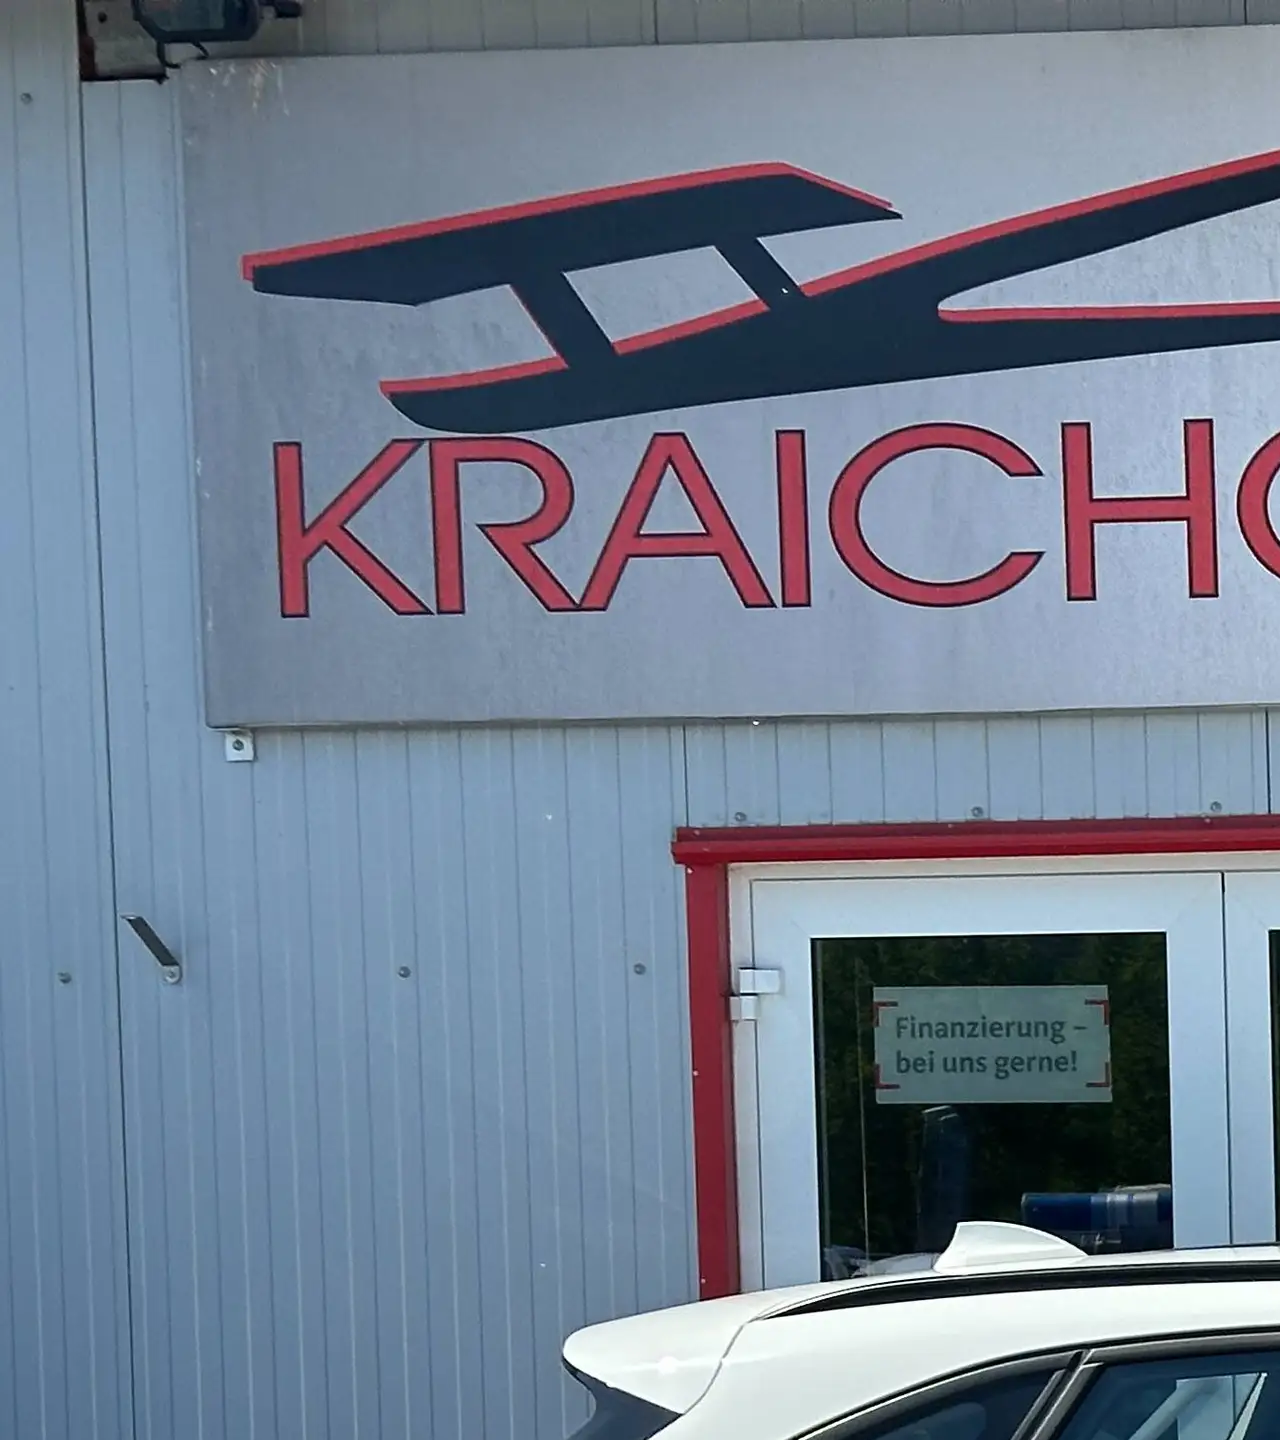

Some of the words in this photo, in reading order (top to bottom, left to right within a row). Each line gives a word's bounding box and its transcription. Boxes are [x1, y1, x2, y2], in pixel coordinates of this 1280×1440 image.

[895, 1016, 1066, 1045] Finanzierung
[895, 1050, 935, 1074] bei
[943, 1054, 988, 1074] uns
[993, 1050, 1078, 1080] gerne!
